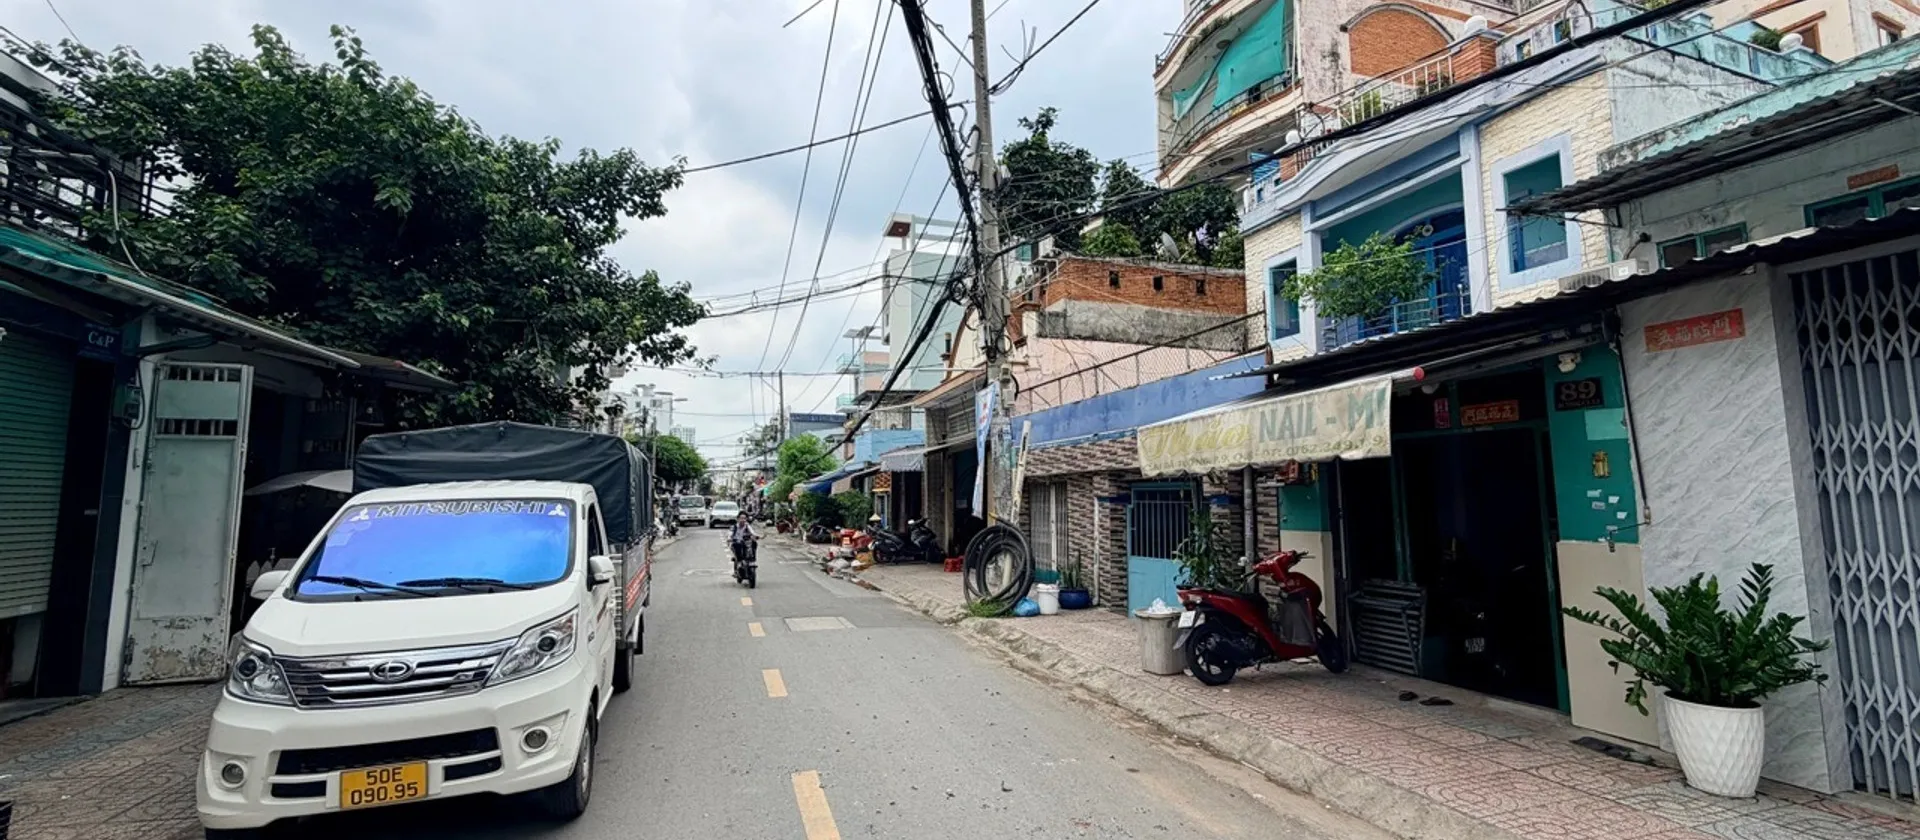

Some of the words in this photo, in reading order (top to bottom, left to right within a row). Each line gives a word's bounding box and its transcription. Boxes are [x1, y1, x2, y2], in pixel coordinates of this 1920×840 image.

[88, 330, 115, 348] C&P
[1560, 380, 1597, 401] 89
[1259, 402, 1318, 443] NAIL
[375, 500, 547, 517] MITSUBISHI
[366, 767, 403, 785] 50E
[350, 782, 418, 805] 090.95
